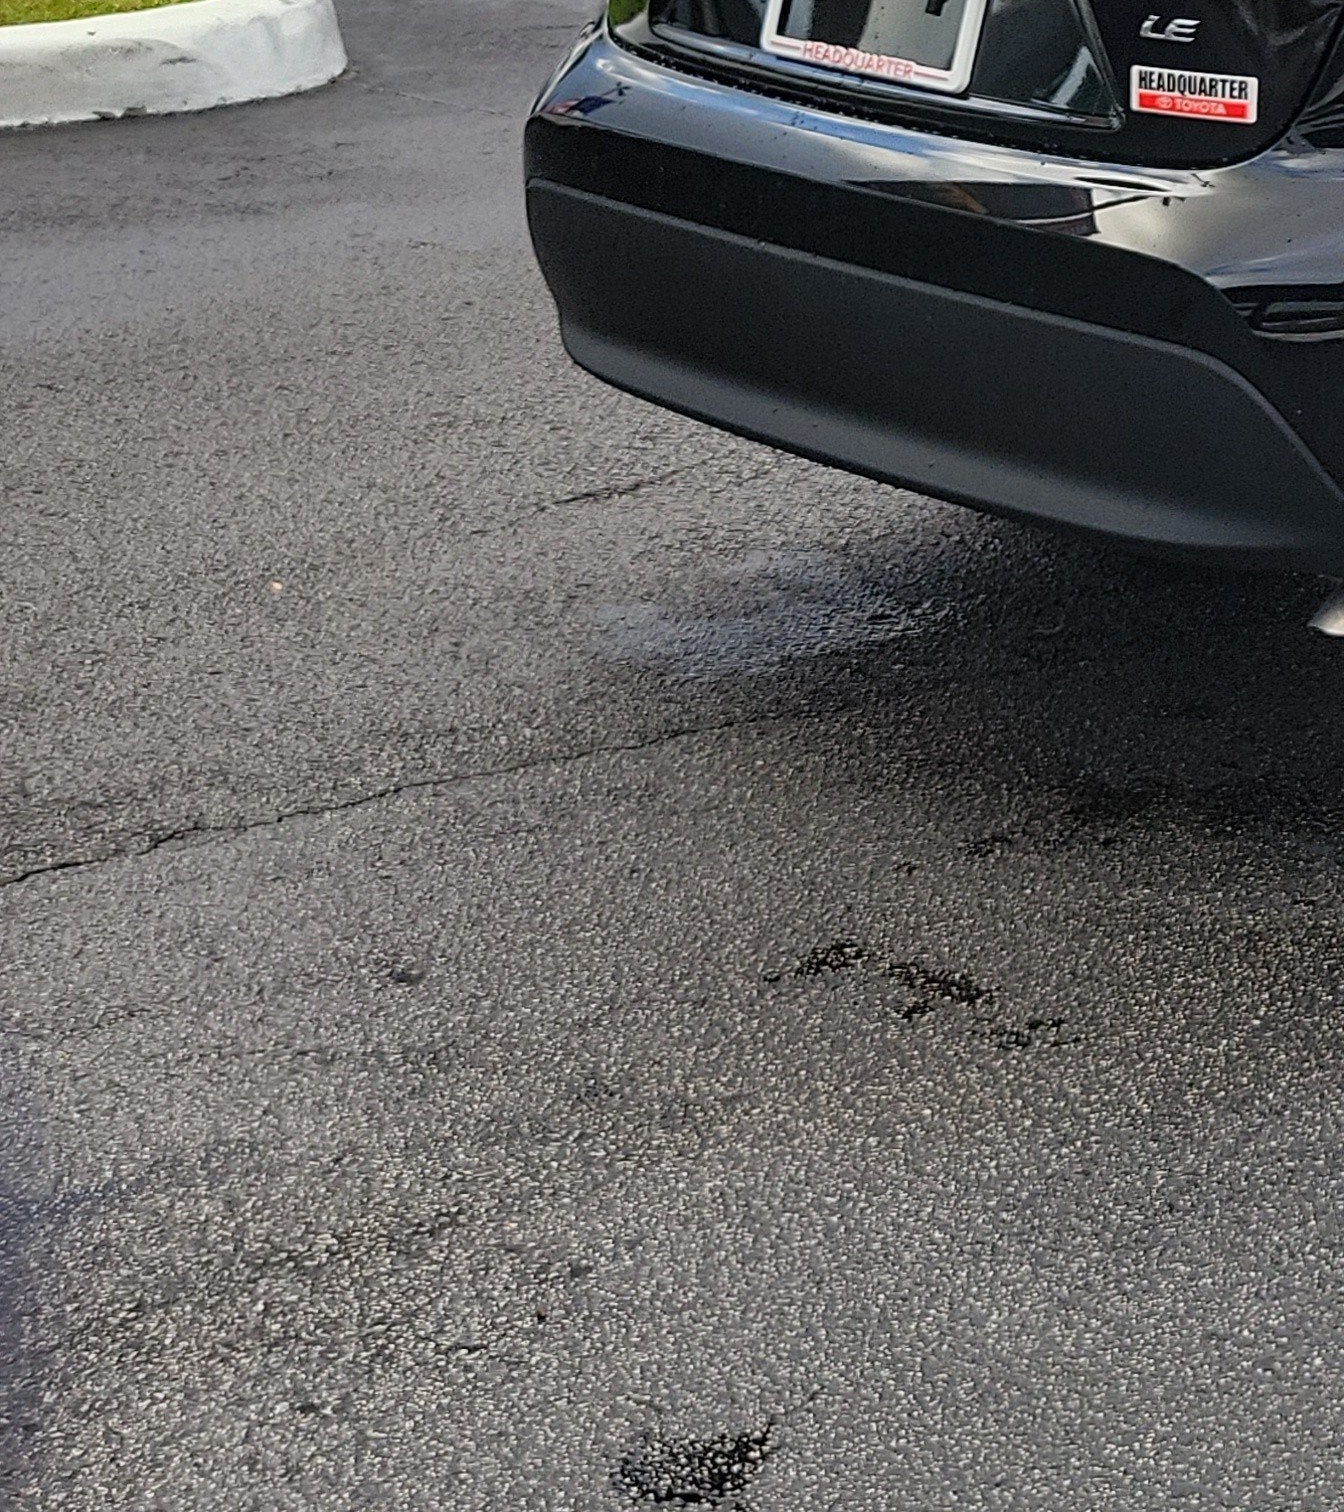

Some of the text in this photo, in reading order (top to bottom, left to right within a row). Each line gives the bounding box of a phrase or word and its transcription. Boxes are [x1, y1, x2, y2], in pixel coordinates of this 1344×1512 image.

[1139, 14, 1201, 43] LE
[802, 42, 914, 79] HEADQUARTER
[1138, 70, 1249, 101] HEADQUARTER
[1173, 97, 1228, 115] TOYOTA
